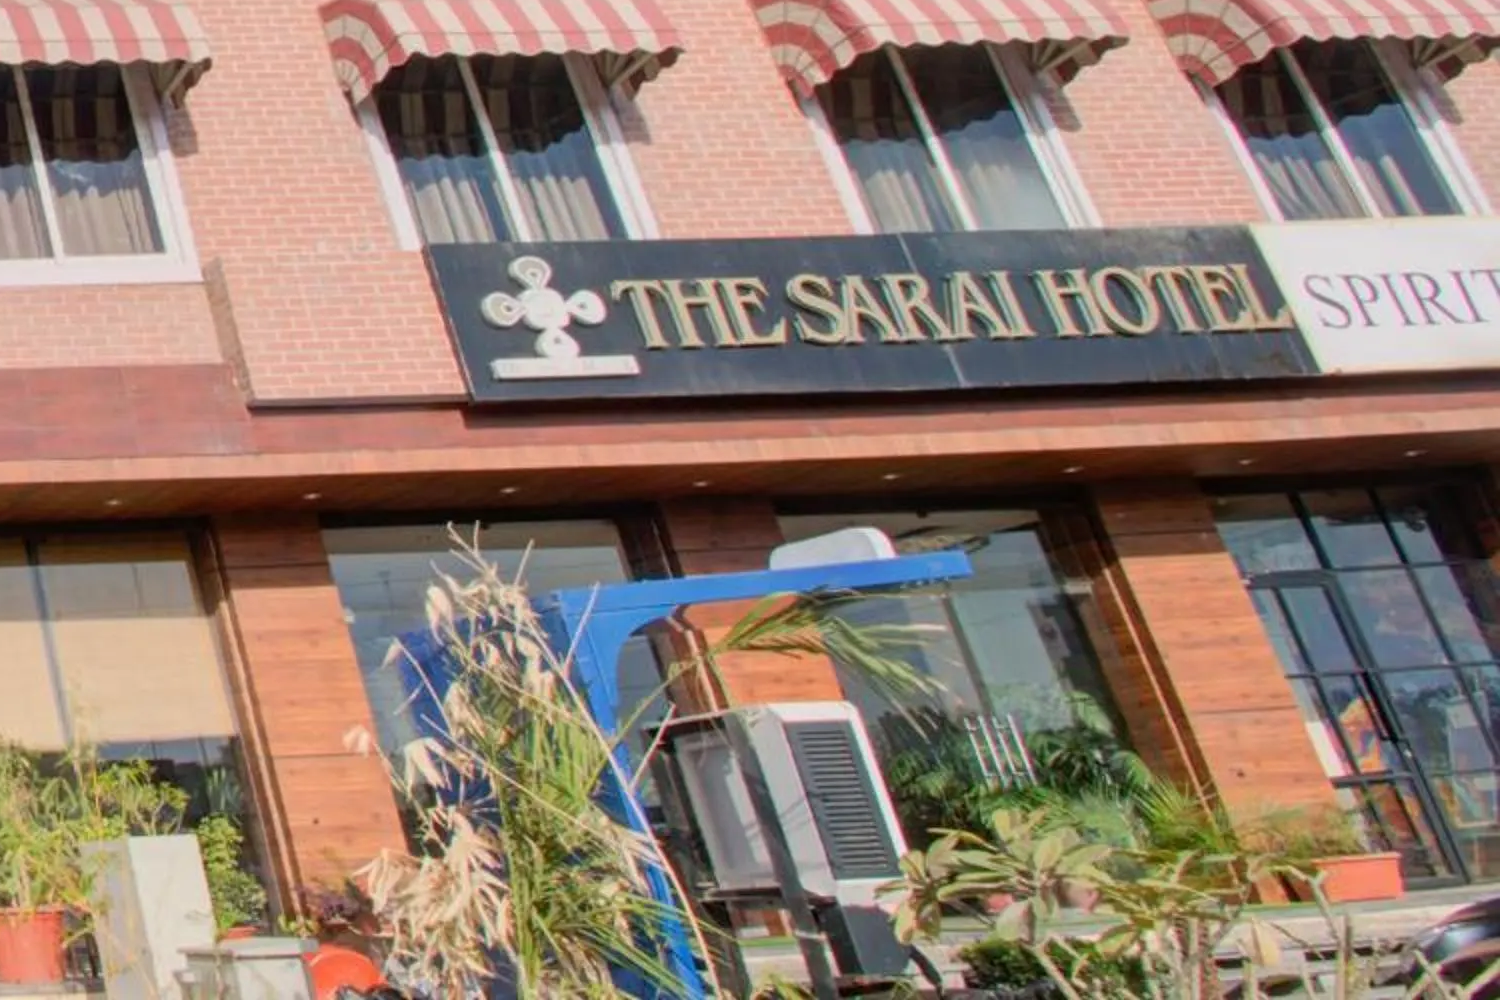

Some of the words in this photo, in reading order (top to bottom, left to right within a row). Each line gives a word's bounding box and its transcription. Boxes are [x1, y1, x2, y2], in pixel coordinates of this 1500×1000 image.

[611, 276, 788, 350] THE
[785, 270, 1037, 346] SARAI
[1031, 263, 1296, 339] HOTEL
